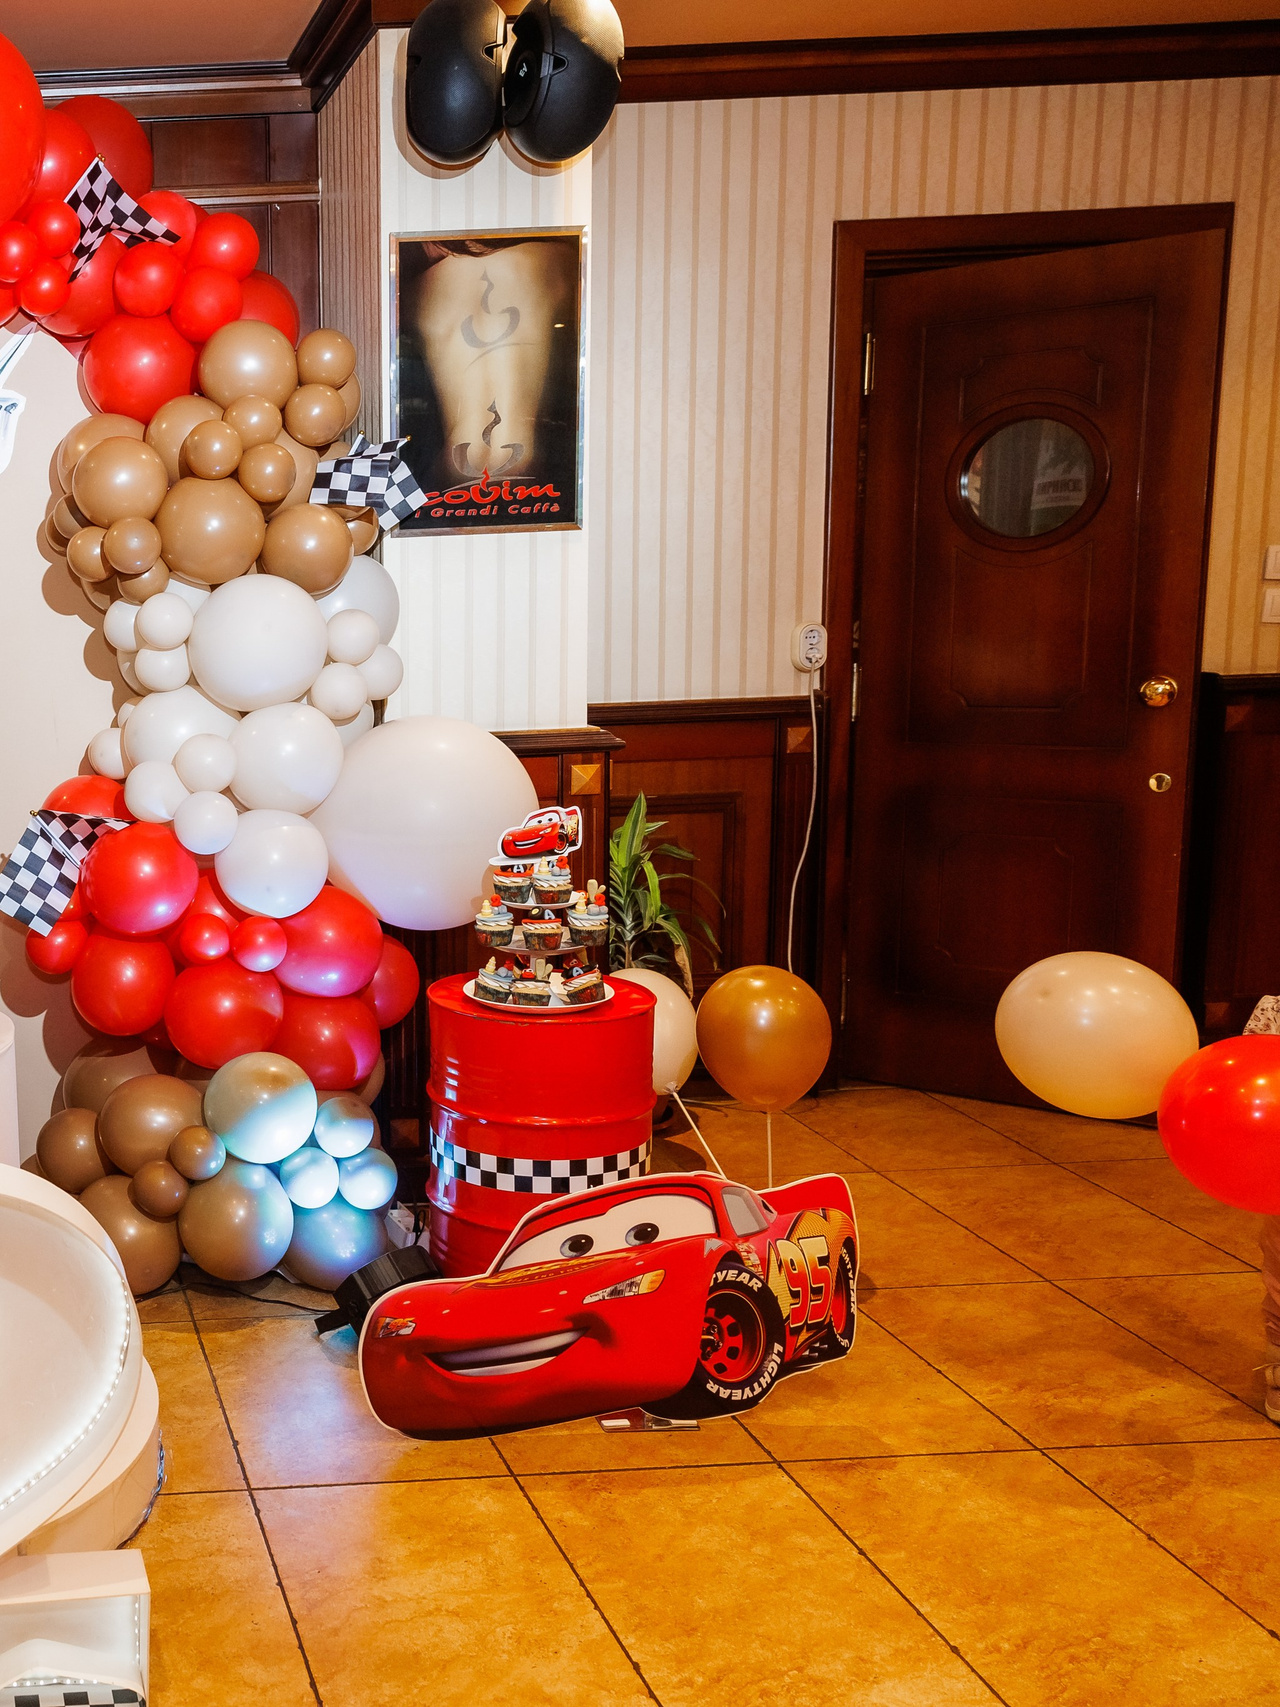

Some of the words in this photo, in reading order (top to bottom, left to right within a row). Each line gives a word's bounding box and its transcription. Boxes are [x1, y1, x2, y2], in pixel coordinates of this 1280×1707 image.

[430, 504, 498, 518] Grandi
[508, 502, 561, 515] Caffè
[776, 1235, 833, 1328] 95
[706, 1342, 784, 1401] LIGHTYEAR
